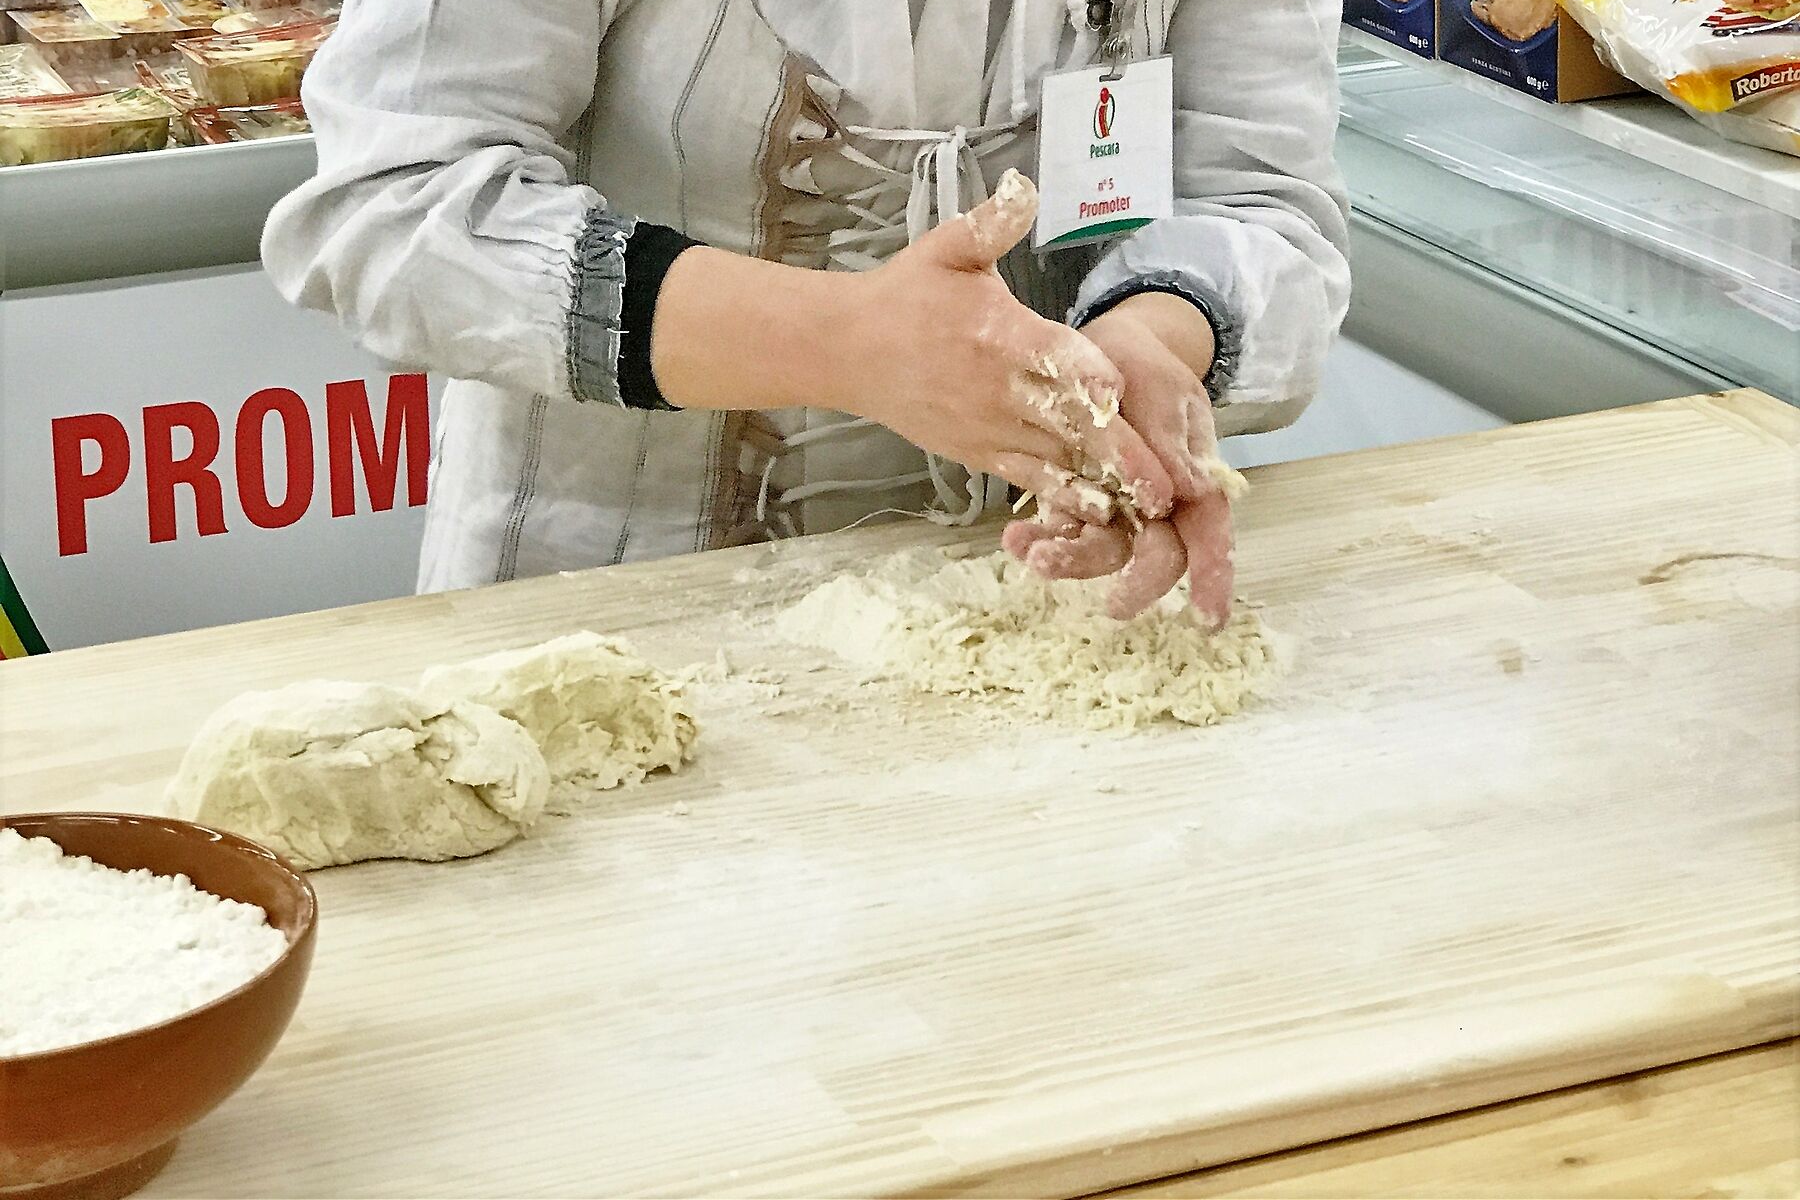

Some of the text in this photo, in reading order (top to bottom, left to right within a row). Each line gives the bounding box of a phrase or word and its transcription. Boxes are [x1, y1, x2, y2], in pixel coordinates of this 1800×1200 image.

[1736, 65, 1800, 96] Roberto
[1090, 141, 1120, 159] Pescara
[1079, 196, 1131, 219] Promoter
[51, 372, 431, 557] PROM
